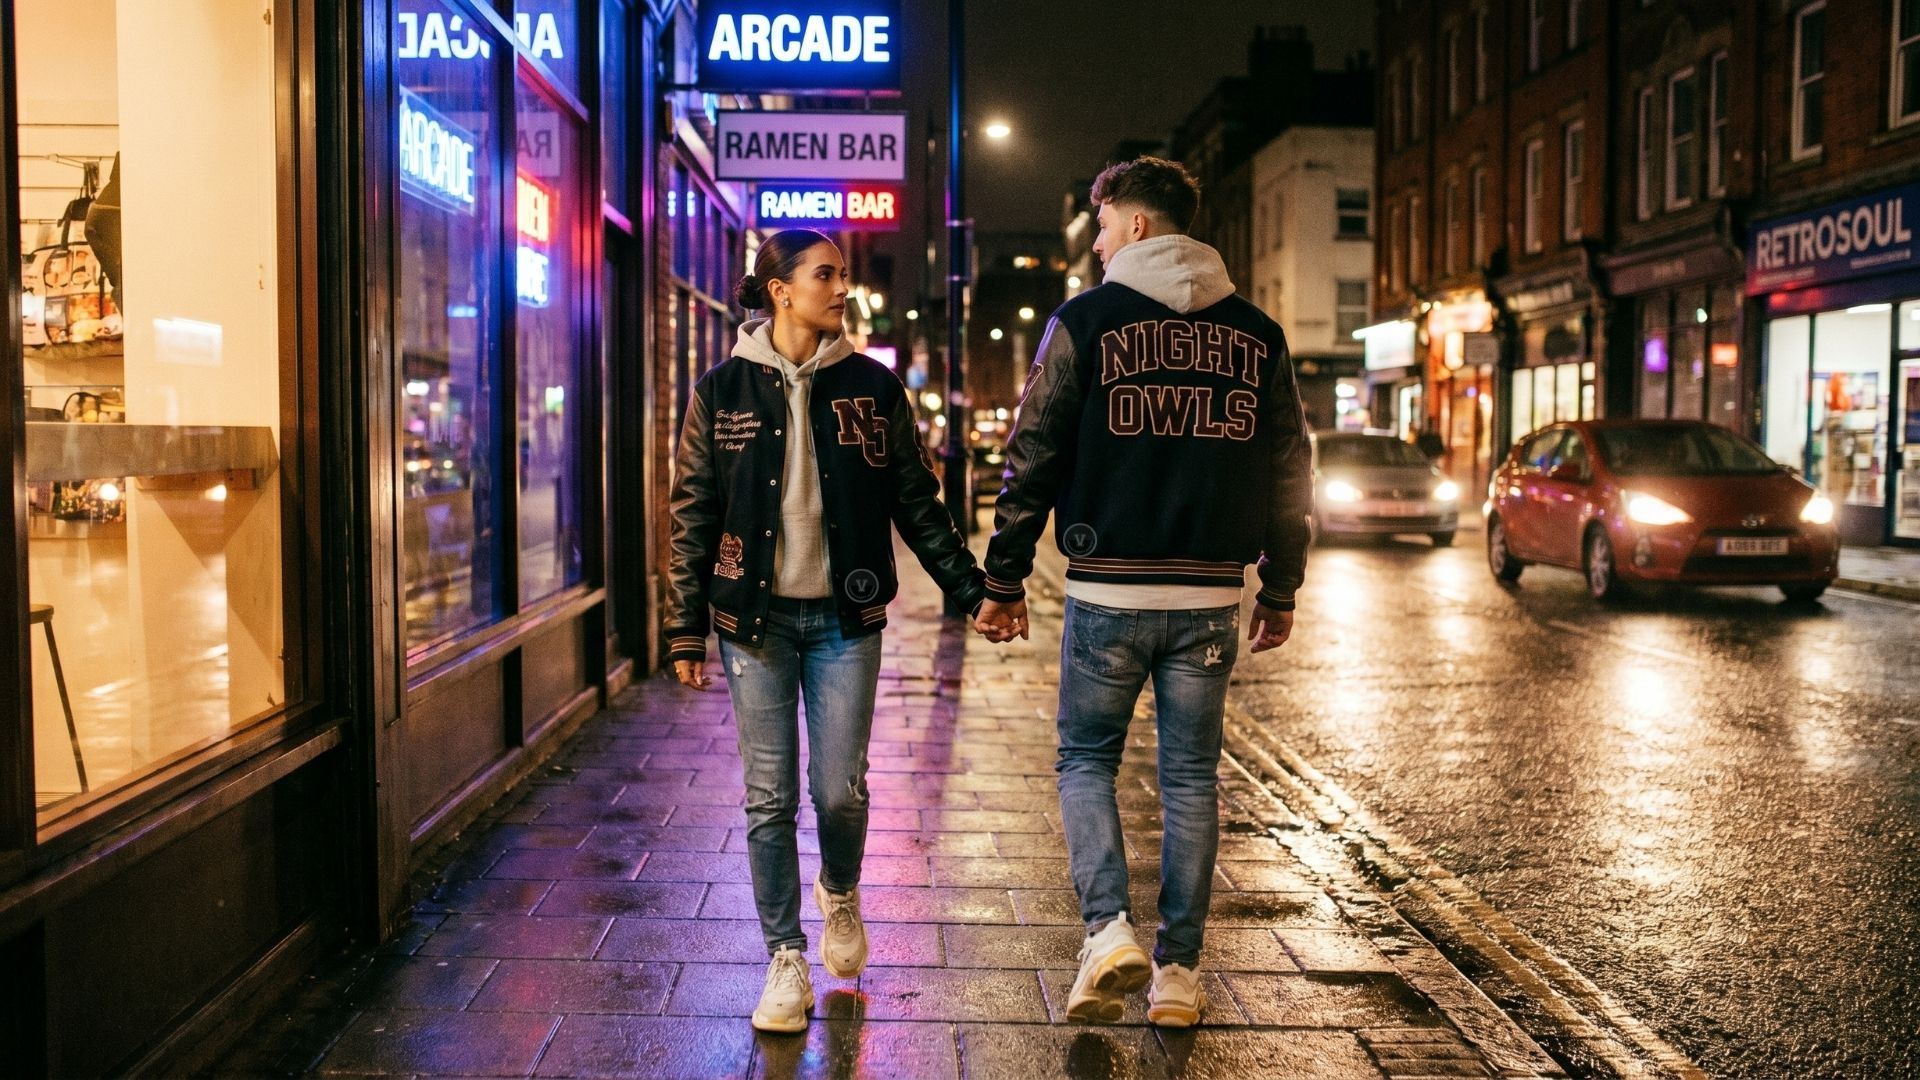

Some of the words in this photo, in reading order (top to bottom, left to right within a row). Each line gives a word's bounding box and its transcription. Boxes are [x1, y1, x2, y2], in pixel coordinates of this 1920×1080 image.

[708, 14, 890, 62] ARCADE
[400, 108, 475, 203] ARCADE
[725, 131, 828, 161] RAMEN
[838, 133, 897, 161] BAR
[760, 191, 843, 219] RAMEN
[846, 191, 895, 219] BAR
[1756, 197, 1912, 270] RETROSOUL
[1101, 319, 1268, 388] NIGHT
[1109, 384, 1258, 441] OWLS
